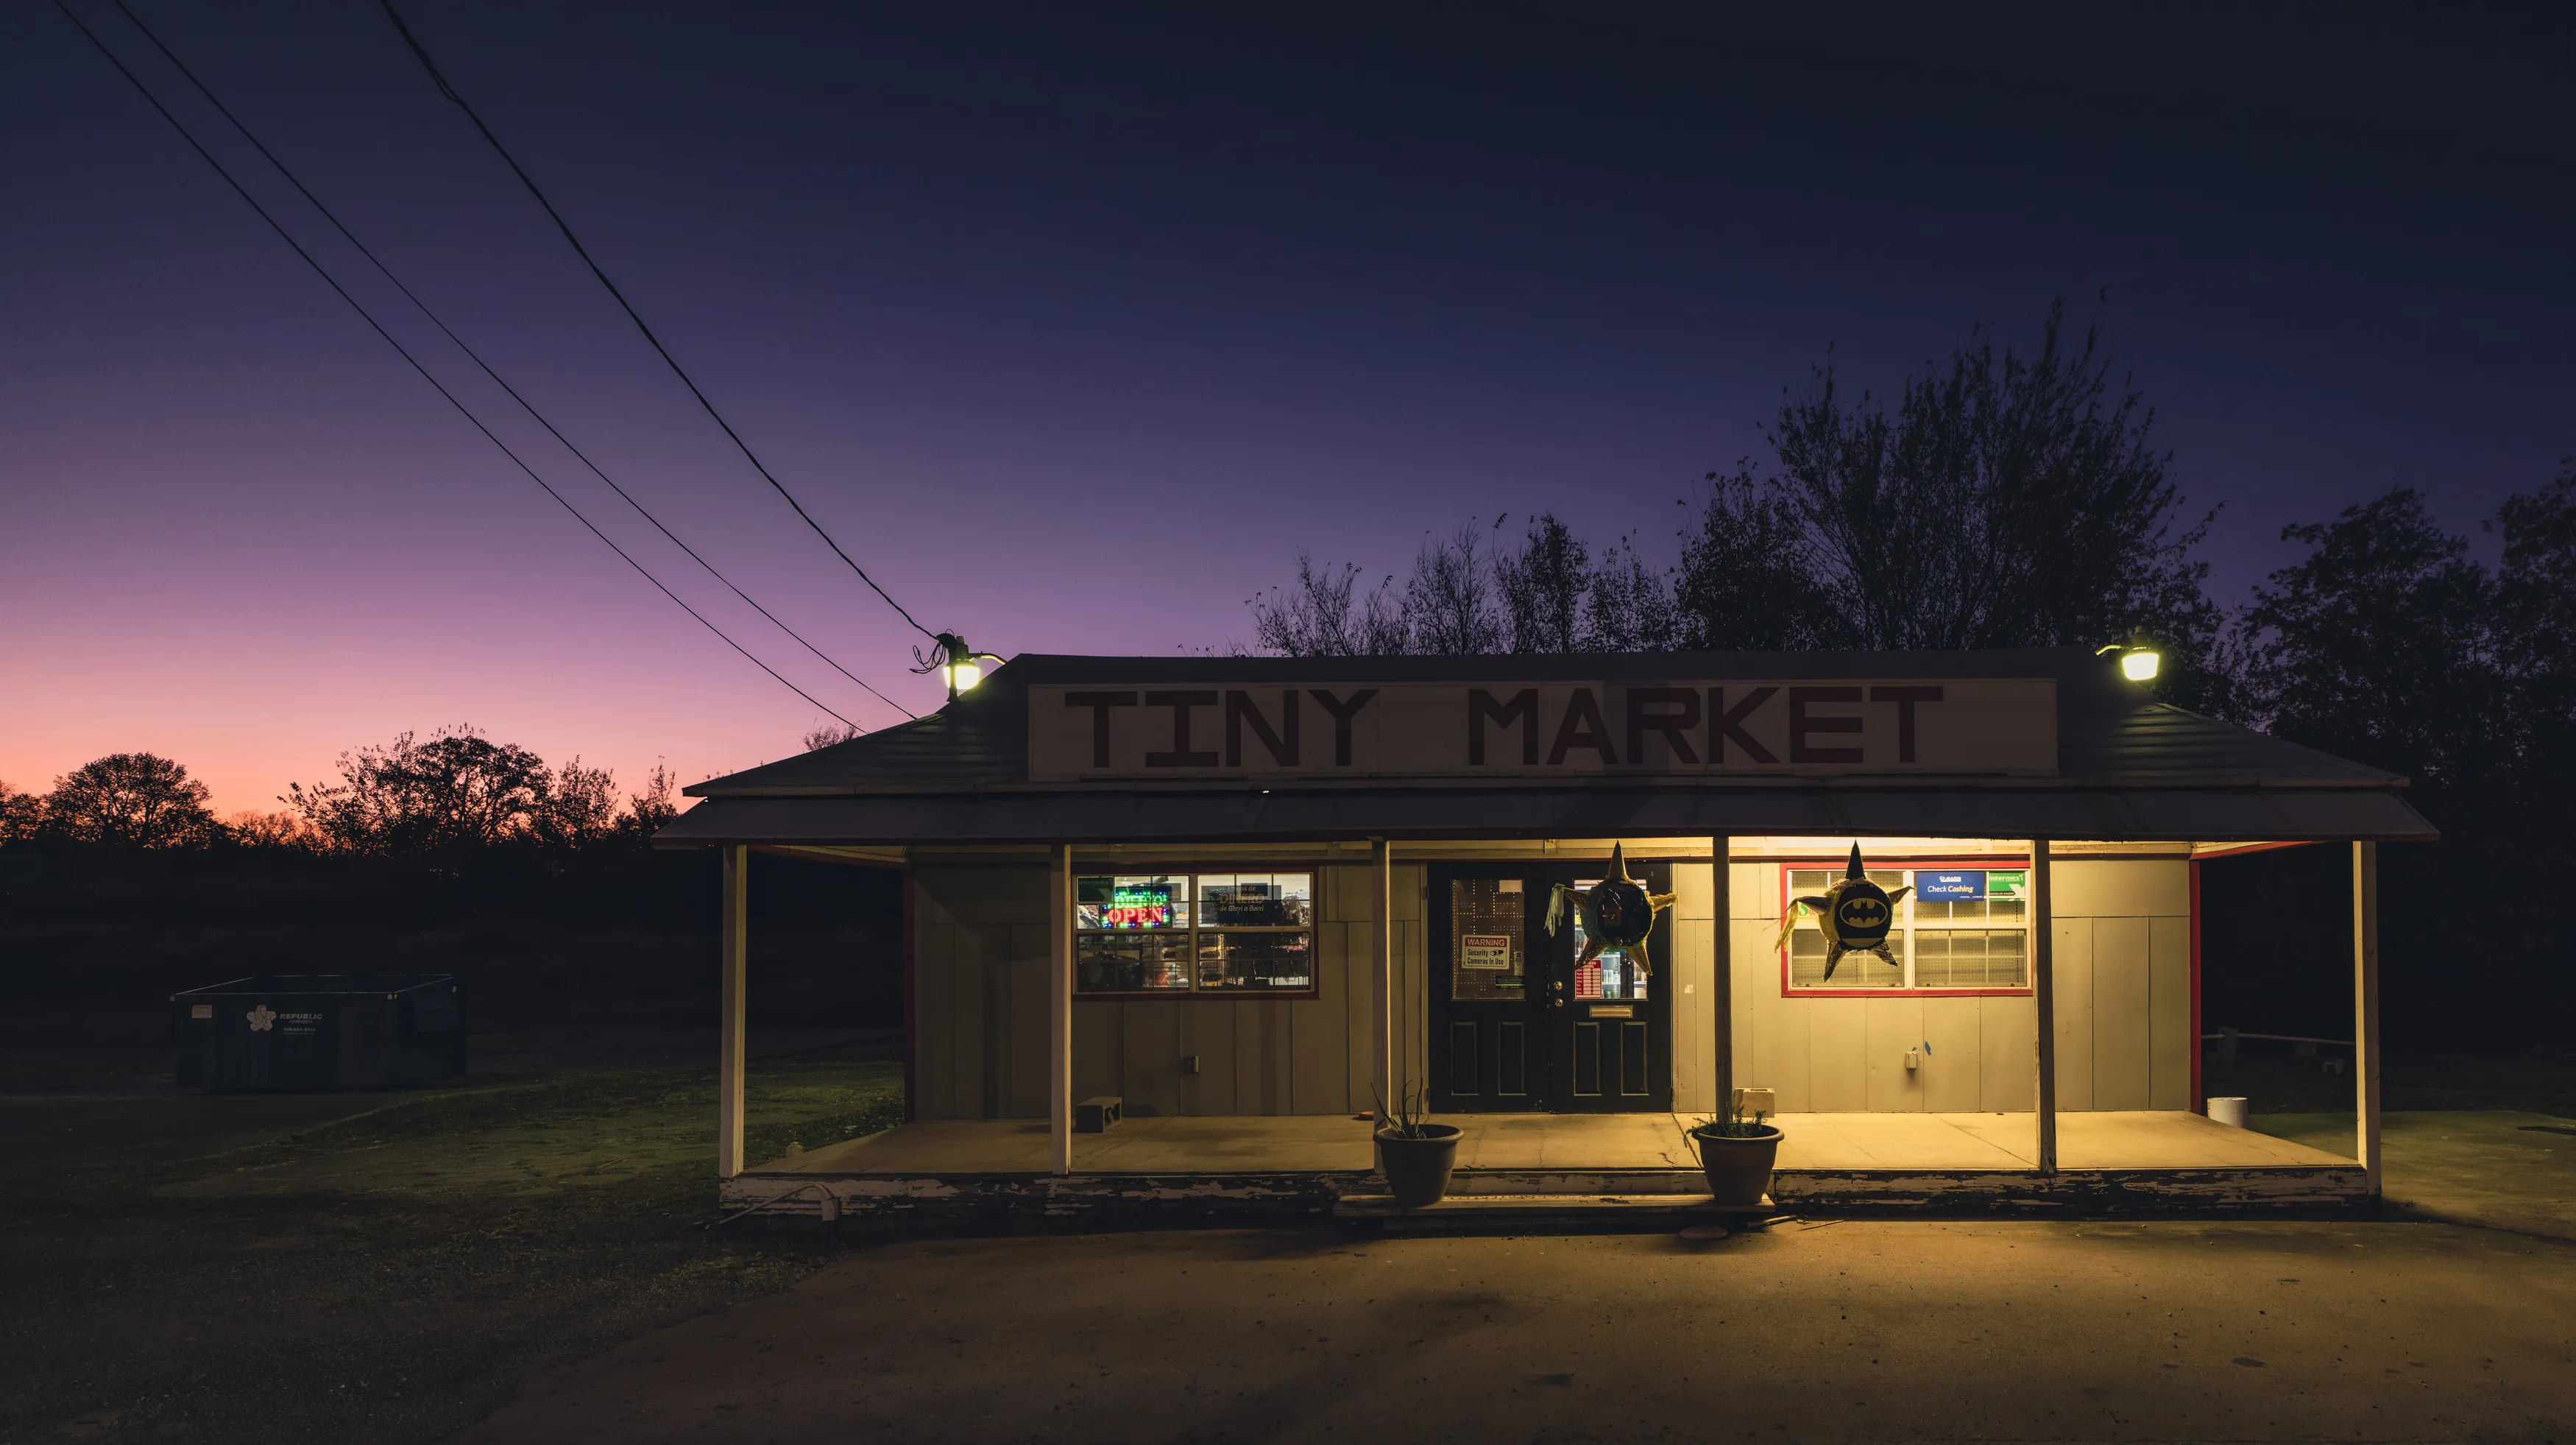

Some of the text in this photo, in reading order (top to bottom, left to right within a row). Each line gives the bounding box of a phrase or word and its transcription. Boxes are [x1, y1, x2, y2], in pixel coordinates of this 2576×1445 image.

[1065, 685, 1943, 769] TINY MARKET
[1947, 886, 1974, 894] Cashing
[1108, 908, 1163, 922] OPEN
[1467, 939, 1505, 947] WARNING
[1468, 949, 1489, 957] Security
